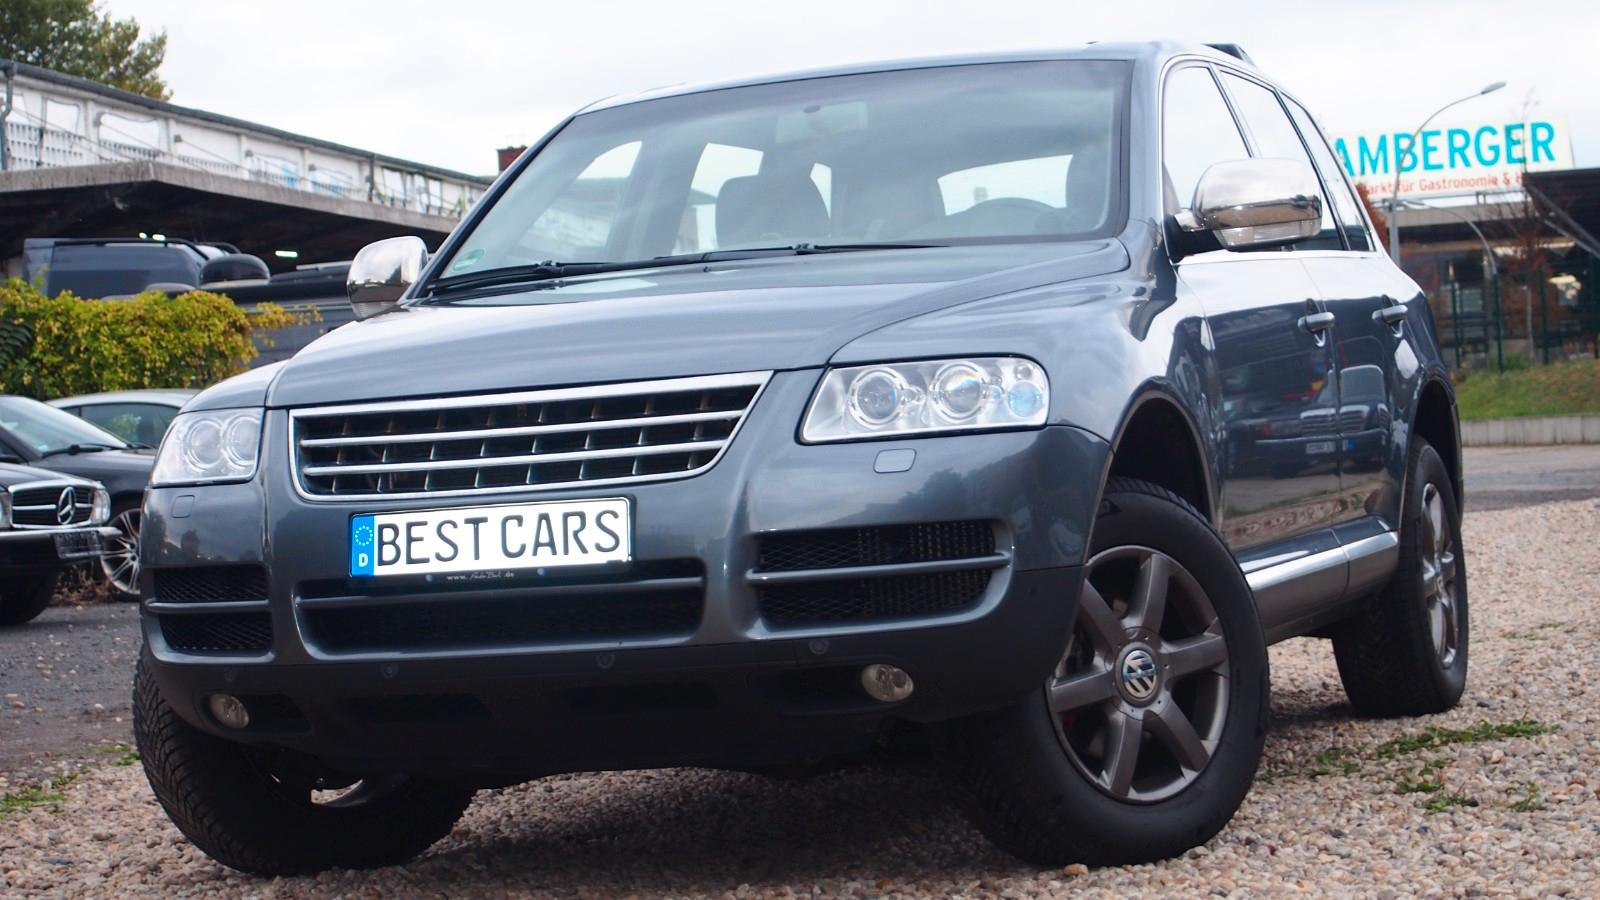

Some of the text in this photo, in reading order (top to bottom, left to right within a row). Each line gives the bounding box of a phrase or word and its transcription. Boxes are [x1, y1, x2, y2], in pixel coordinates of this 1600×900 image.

[1418, 172, 1498, 191] Gastronomie
[376, 509, 621, 567] BEST CARS
[358, 552, 369, 567] D
